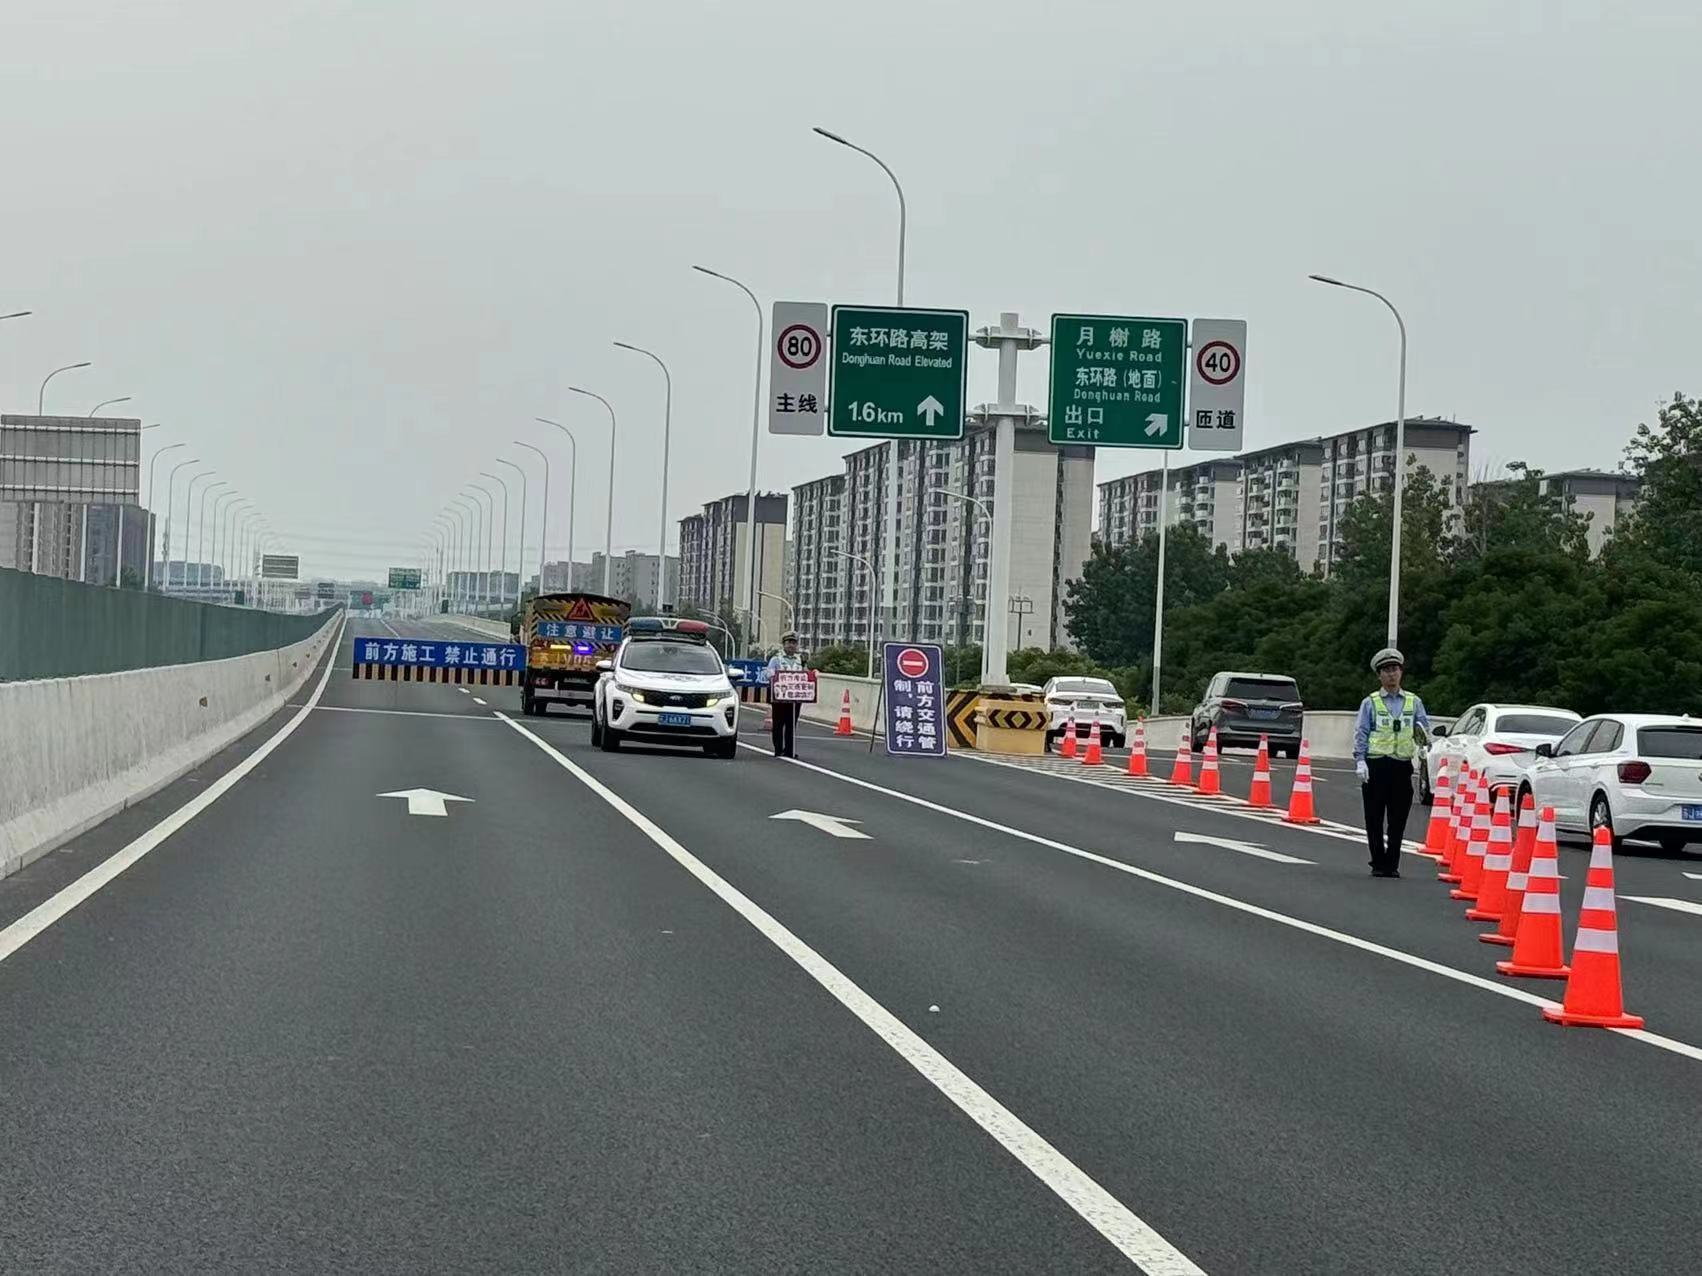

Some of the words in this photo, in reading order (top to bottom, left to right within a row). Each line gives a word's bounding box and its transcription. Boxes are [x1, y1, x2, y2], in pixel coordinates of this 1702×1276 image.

[787, 336, 812, 356] 80
[849, 326, 949, 351] 东环路高架
[1076, 326, 1162, 349] 月榭路
[842, 352, 886, 367] Donghuan
[888, 353, 912, 367] Road
[915, 355, 953, 369] Elevated
[1076, 348, 1124, 360] Yuexie
[1129, 351, 1162, 363] Road
[1205, 352, 1231, 373] 40
[776, 393, 818, 414] 主线
[1073, 388, 1130, 403] Donghuan
[1134, 391, 1161, 403] Road
[1064, 404, 1104, 425] 出口
[1195, 409, 1236, 430] 匝道
[1066, 427, 1100, 440] Exit
[364, 641, 436, 663] 前方施工
[444, 644, 517, 667] 禁止通行
[915, 680, 937, 749] 前方交通管
